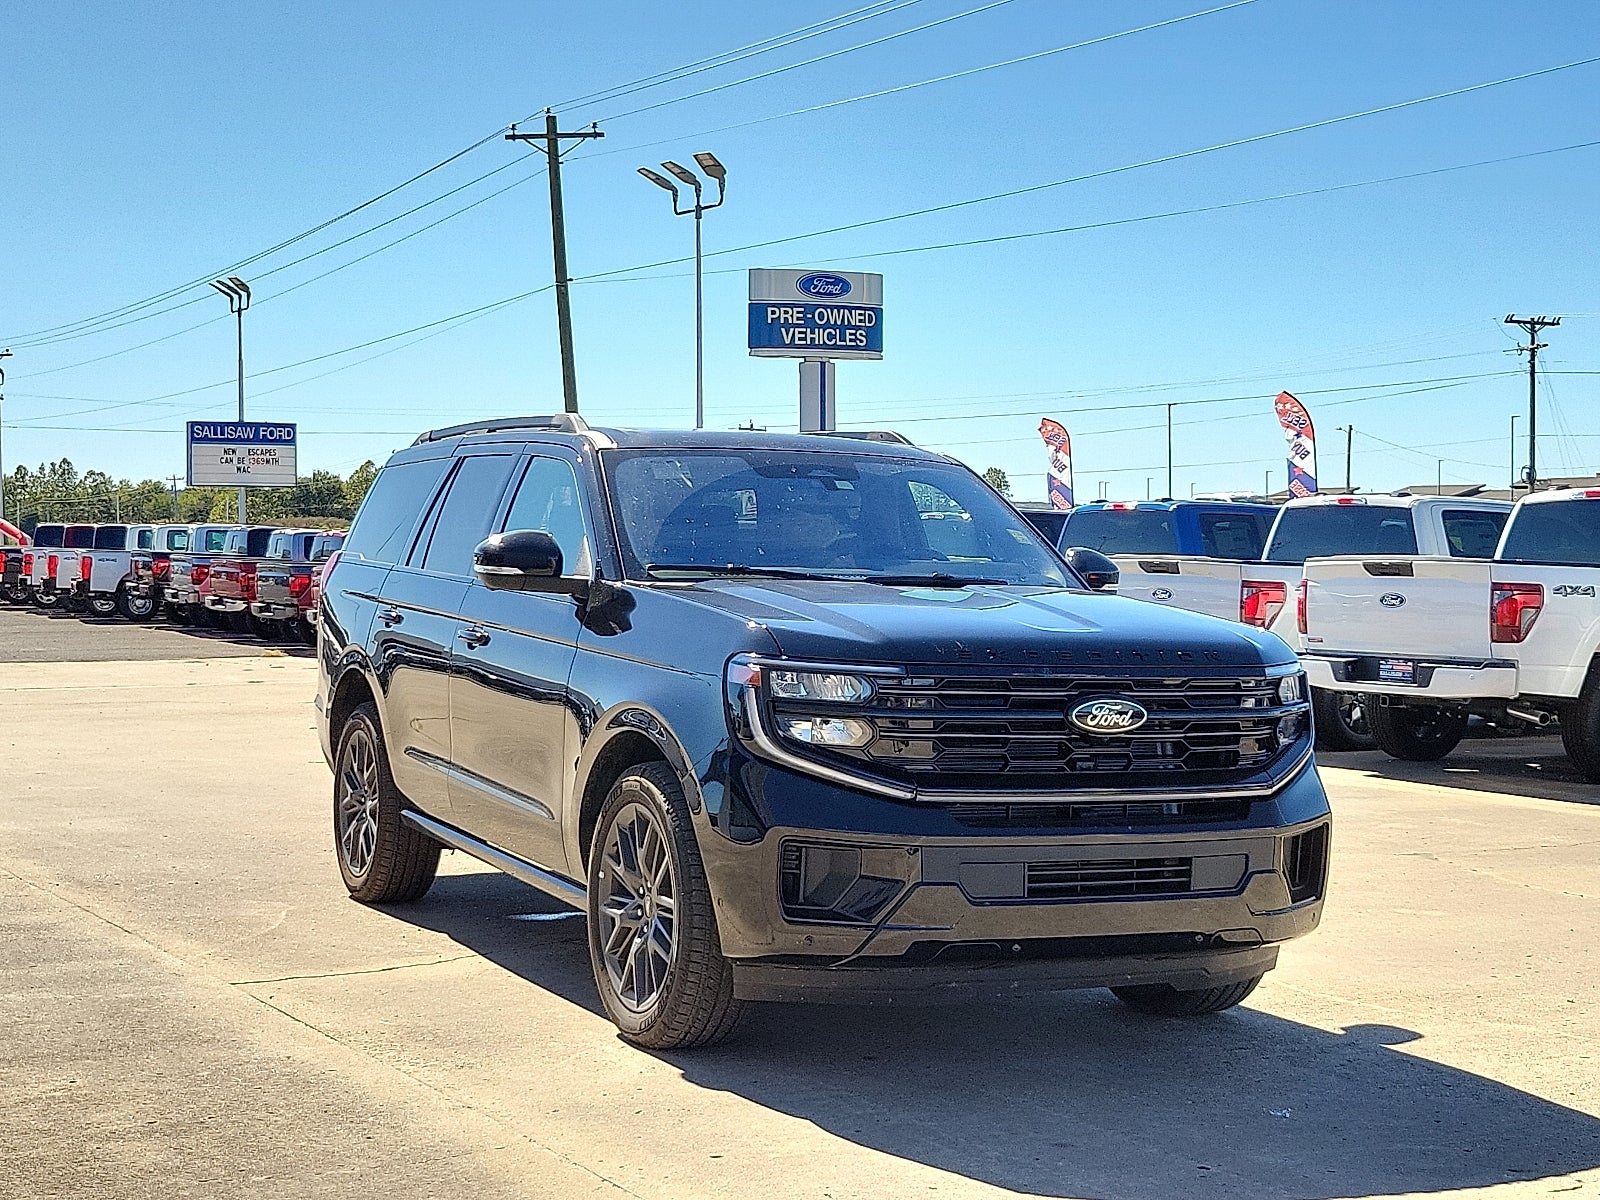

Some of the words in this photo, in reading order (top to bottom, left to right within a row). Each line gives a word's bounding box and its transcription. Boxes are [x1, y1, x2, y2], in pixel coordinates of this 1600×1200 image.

[809, 276, 843, 295] Ford
[767, 307, 876, 327] PRE-OWNED
[781, 327, 867, 347] VEHICLES
[193, 425, 255, 440] SALLISAW
[259, 427, 294, 441] FORD
[223, 447, 238, 456] NEW
[247, 448, 277, 456] ESCAPES
[219, 456, 235, 465] CAN
[237, 457, 246, 465] BE
[236, 465, 251, 474] WAC
[1086, 703, 1134, 726] Ford
